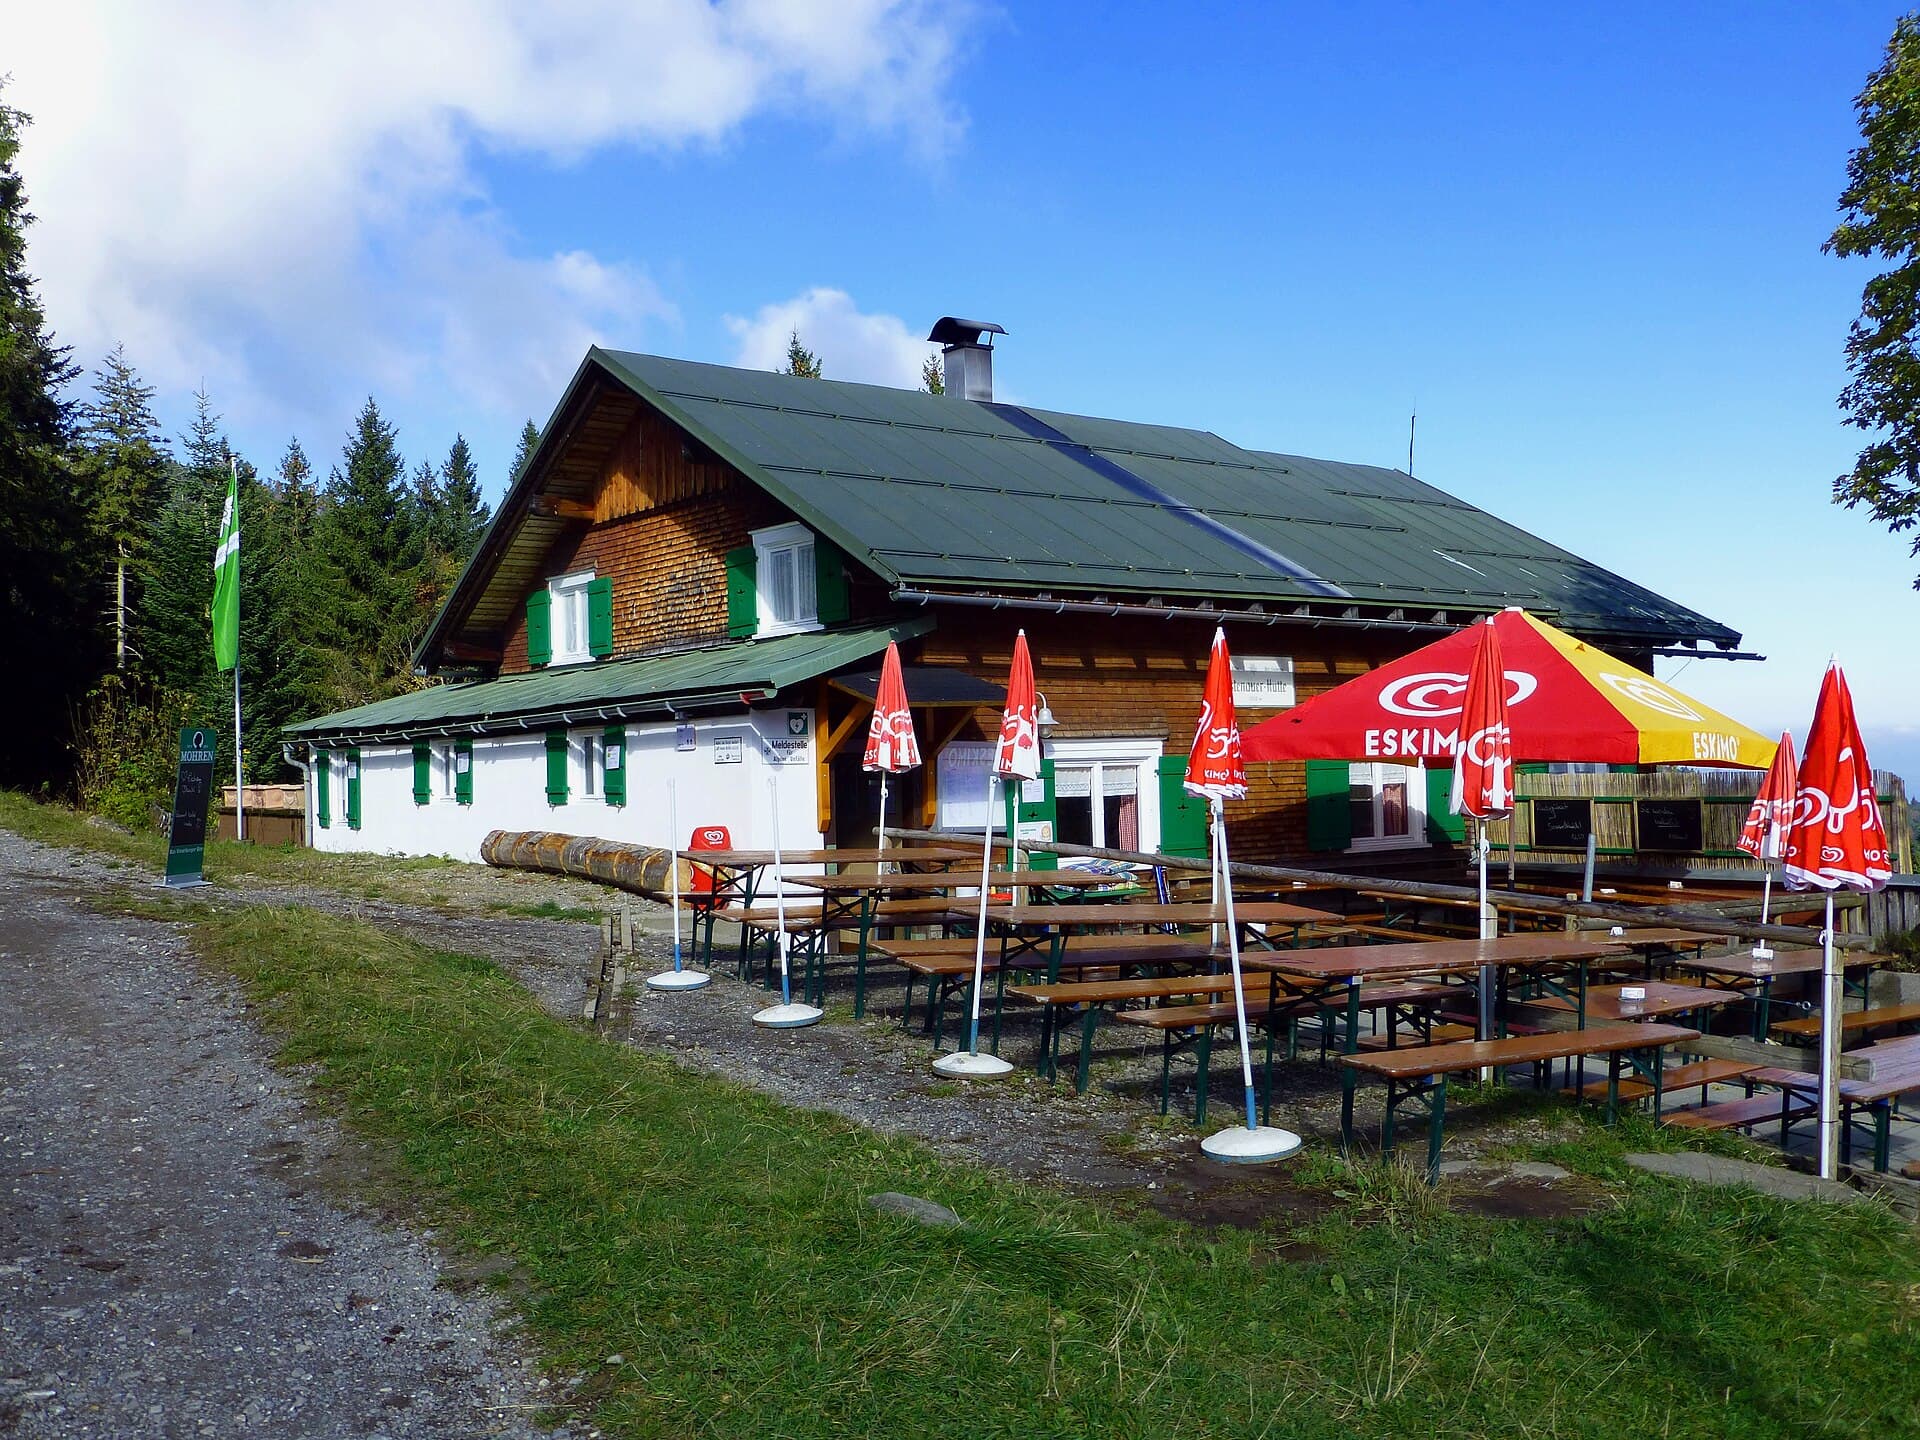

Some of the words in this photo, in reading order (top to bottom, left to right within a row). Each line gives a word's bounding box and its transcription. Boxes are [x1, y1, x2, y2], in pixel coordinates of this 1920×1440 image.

[771, 740, 808, 749] Meldestelle
[1365, 727, 1458, 756] ESKIM
[1693, 731, 1738, 761] ESKIMO
[180, 750, 215, 762] MOHREN
